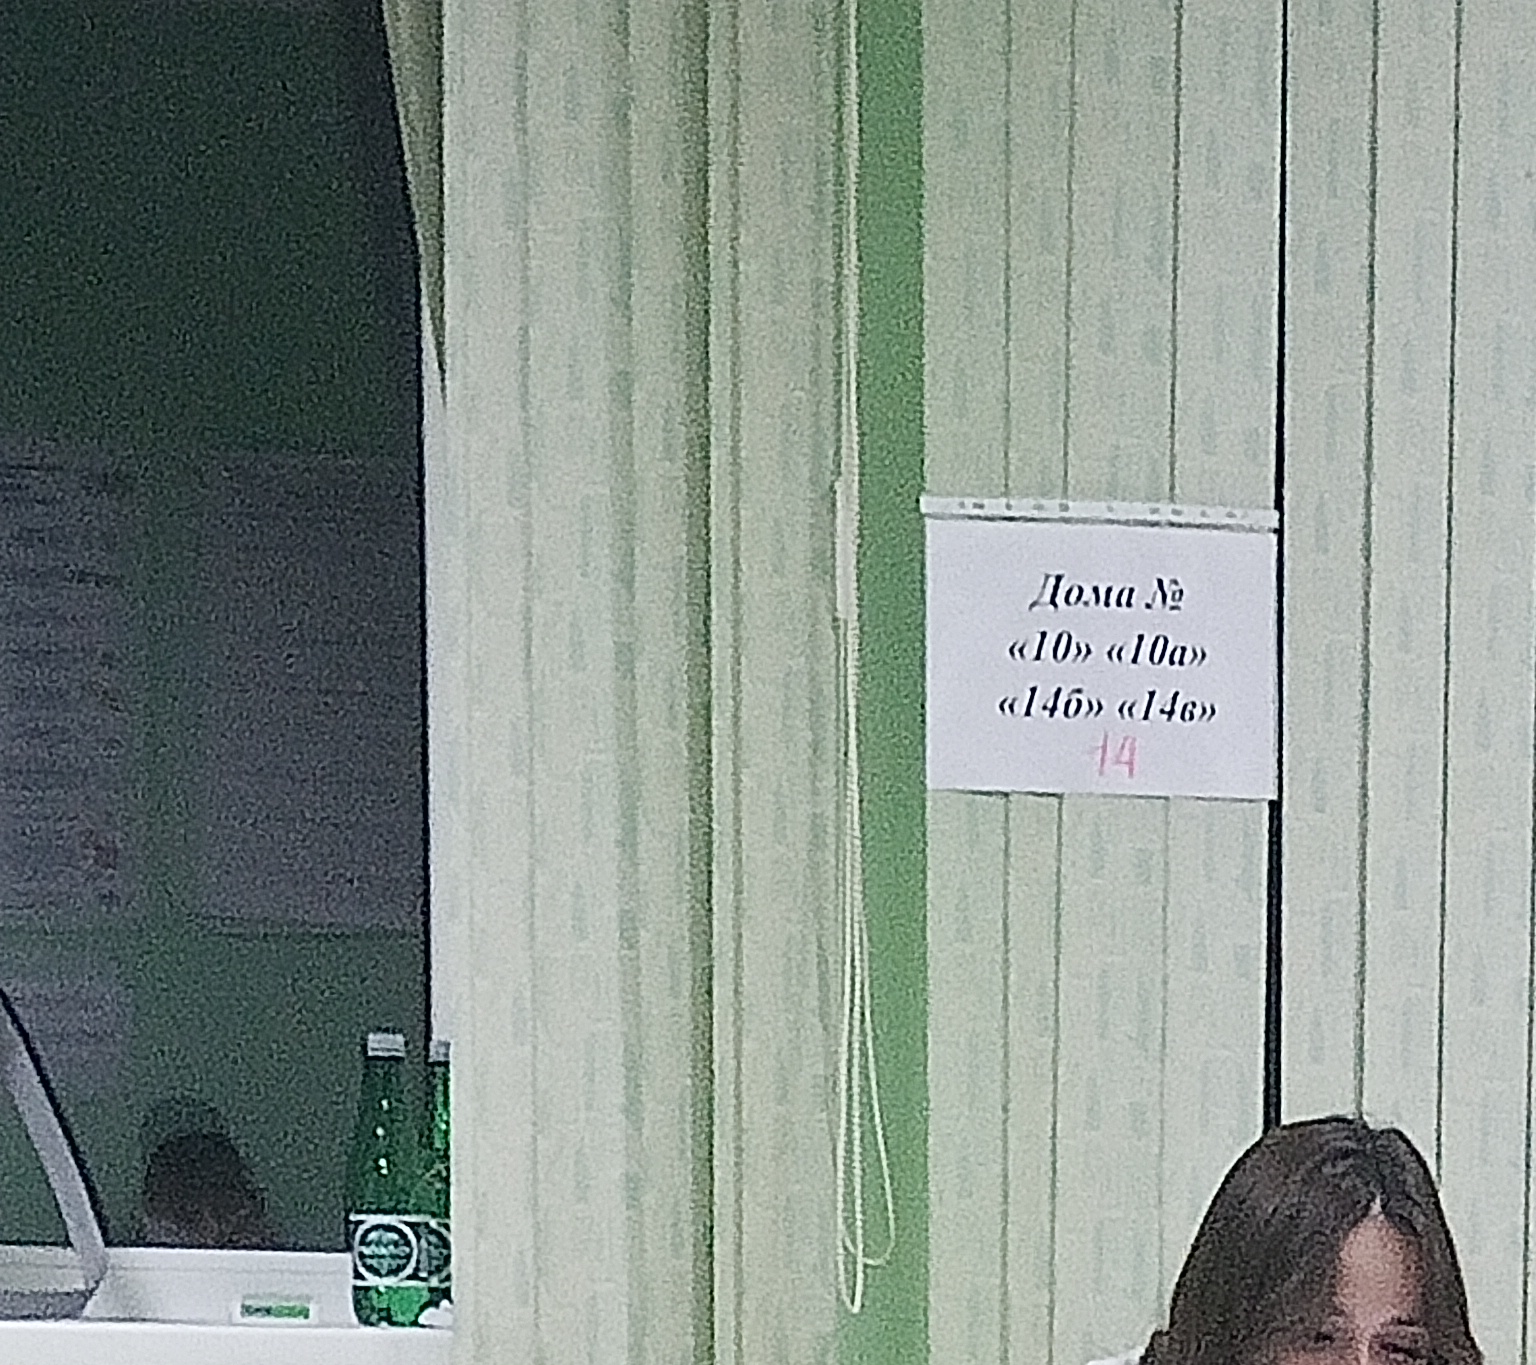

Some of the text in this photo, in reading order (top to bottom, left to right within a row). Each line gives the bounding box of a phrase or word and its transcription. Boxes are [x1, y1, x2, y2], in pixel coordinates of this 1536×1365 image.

[1028, 573, 1185, 613] Дома №
[1007, 630, 1208, 667] «10» «10а»
[998, 685, 1217, 723] «14б» «14в»
[1092, 731, 1137, 779] 14
